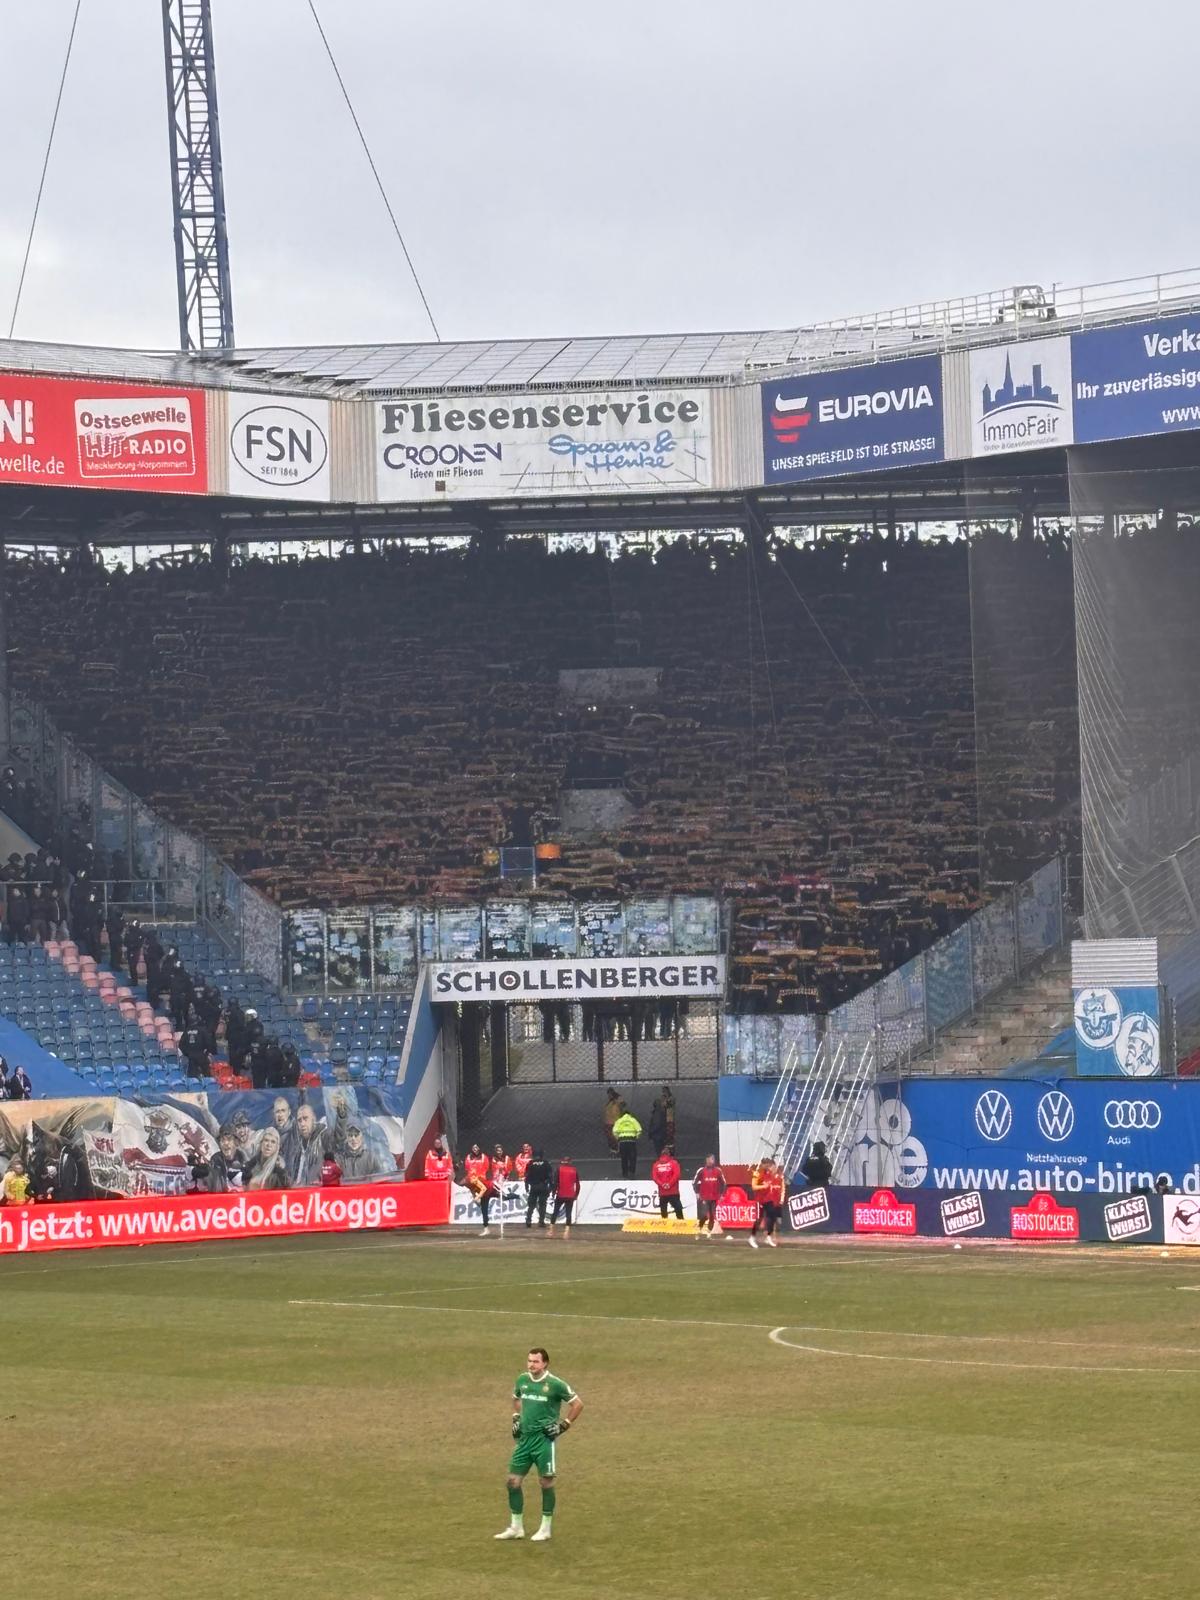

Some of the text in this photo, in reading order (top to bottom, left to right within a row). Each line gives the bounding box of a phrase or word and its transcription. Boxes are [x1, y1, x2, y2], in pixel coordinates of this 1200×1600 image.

[1076, 382, 1099, 400] Ihr
[381, 395, 700, 434] Fliesenservice
[818, 385, 934, 423] EUROVIA
[79, 406, 187, 429] Ostseewelle
[983, 413, 1060, 442] ImmoFair
[246, 424, 312, 464] FSN
[653, 429, 678, 454] &
[383, 441, 502, 470] CROONEN
[772, 455, 805, 471] UNSER
[806, 448, 854, 466] SPIELFELD
[856, 445, 871, 459] IST
[872, 443, 889, 457] DIE
[260, 466, 277, 476] SEIT
[436, 965, 718, 993] SCHOLLENBERGER
[1107, 1135, 1132, 1145] Audi
[791, 1192, 824, 1211] KLASSE
[944, 1195, 979, 1215] KLASSE
[1107, 1200, 1145, 1220] KLASSE
[17, 1210, 94, 1250] jetzt:
[98, 1192, 398, 1237] www.avedo.de/kogge
[794, 1206, 826, 1226] WURST
[855, 1208, 913, 1227] ROSTOCKER
[947, 1211, 980, 1231] WURST
[1012, 1213, 1075, 1232] ROSTOCKER
[1110, 1215, 1147, 1237] WURST
